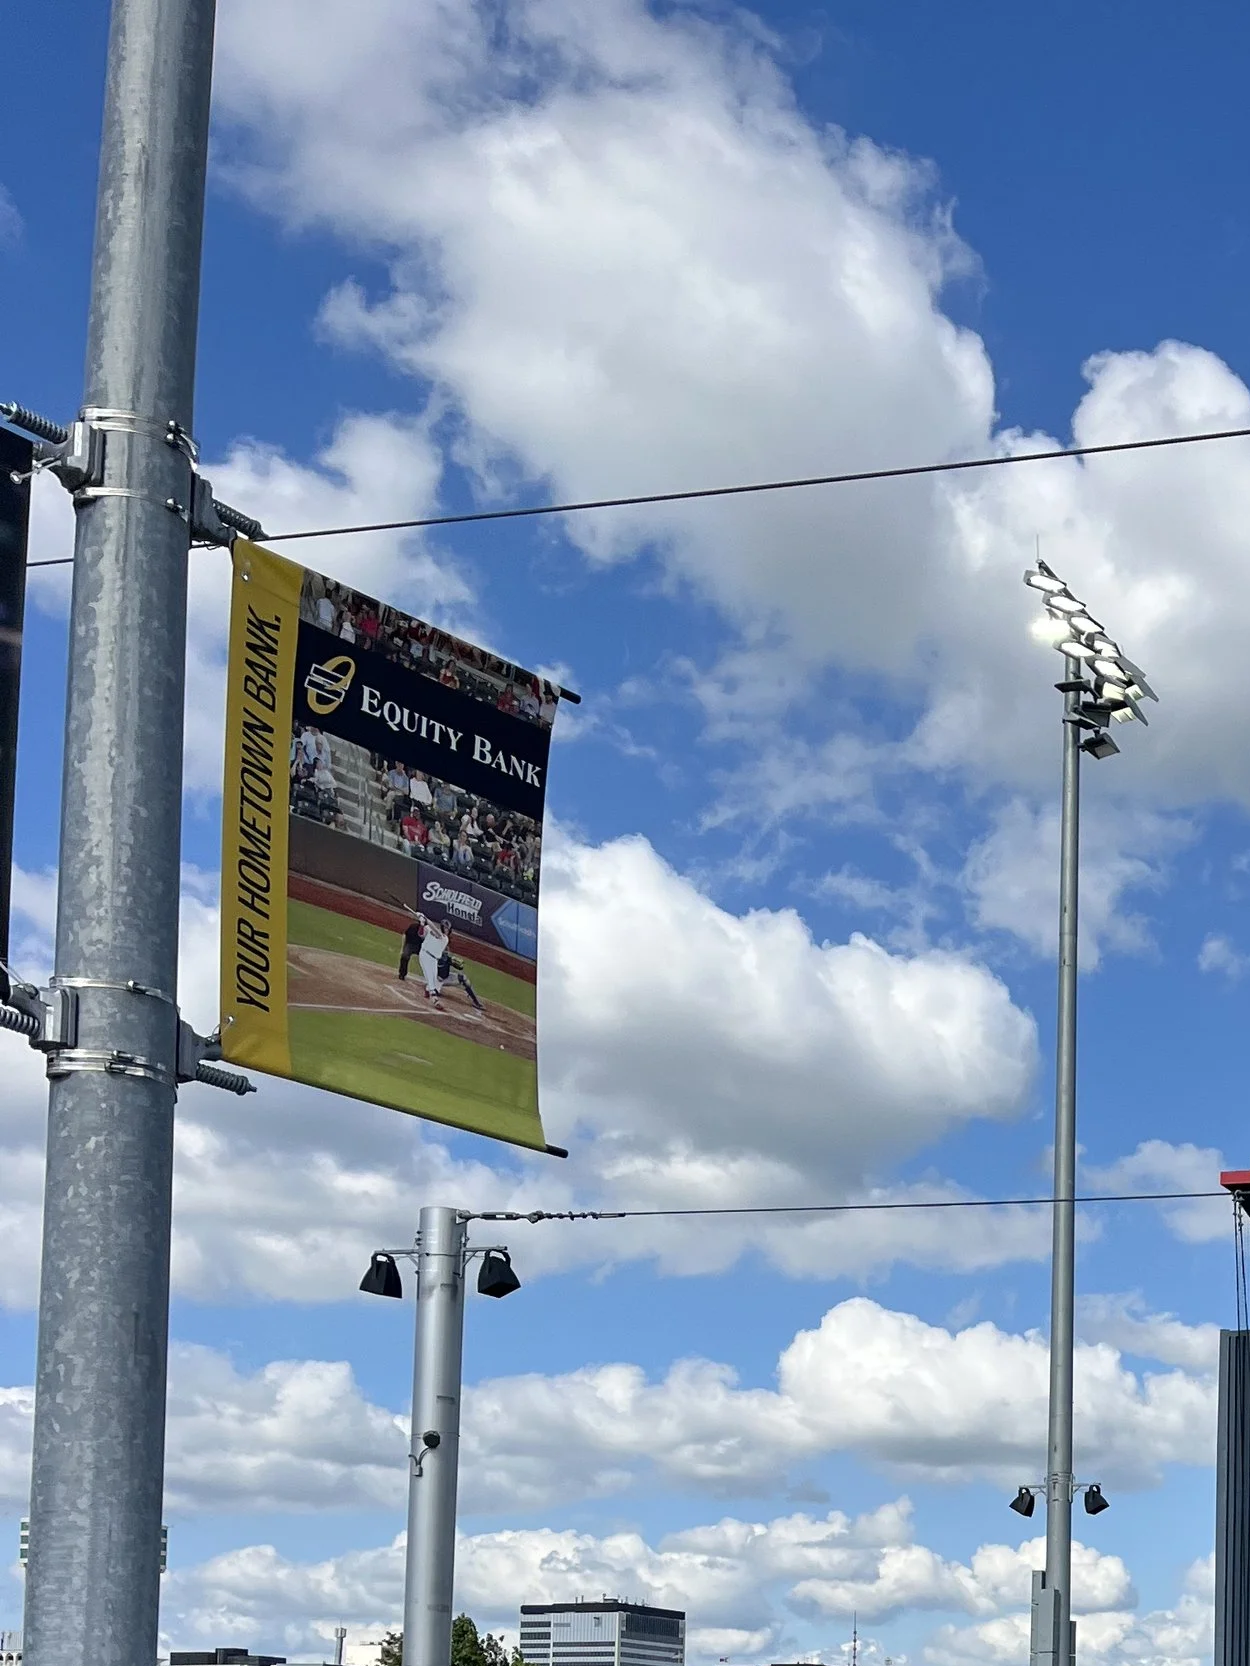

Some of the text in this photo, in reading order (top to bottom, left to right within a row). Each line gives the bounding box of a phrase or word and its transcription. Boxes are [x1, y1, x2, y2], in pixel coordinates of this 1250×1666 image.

[360, 684, 542, 788] EQUITY BANK
[236, 605, 281, 1013] YOUR HOMETOWN BANK.
[446, 901, 483, 927] Honda
